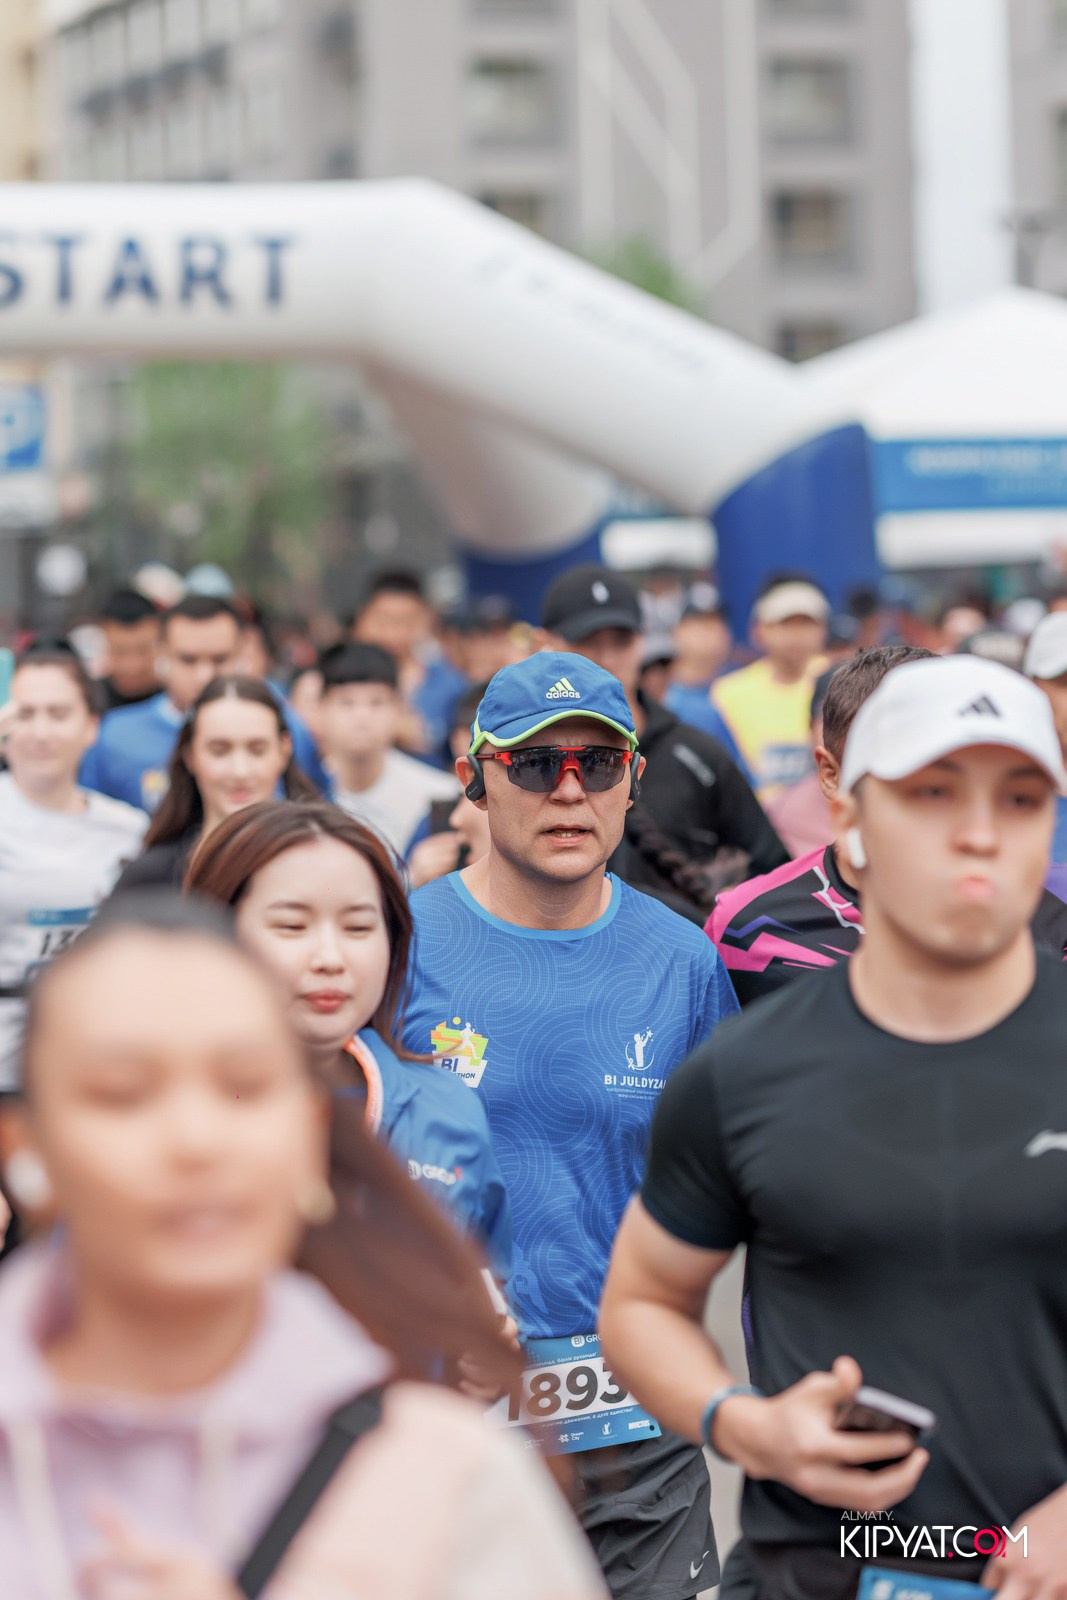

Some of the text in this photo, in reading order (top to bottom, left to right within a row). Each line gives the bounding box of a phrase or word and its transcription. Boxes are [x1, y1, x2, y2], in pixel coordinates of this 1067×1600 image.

[545, 690, 581, 699] adidas
[441, 1058, 459, 1073] BI
[604, 1075, 617, 1086] BI
